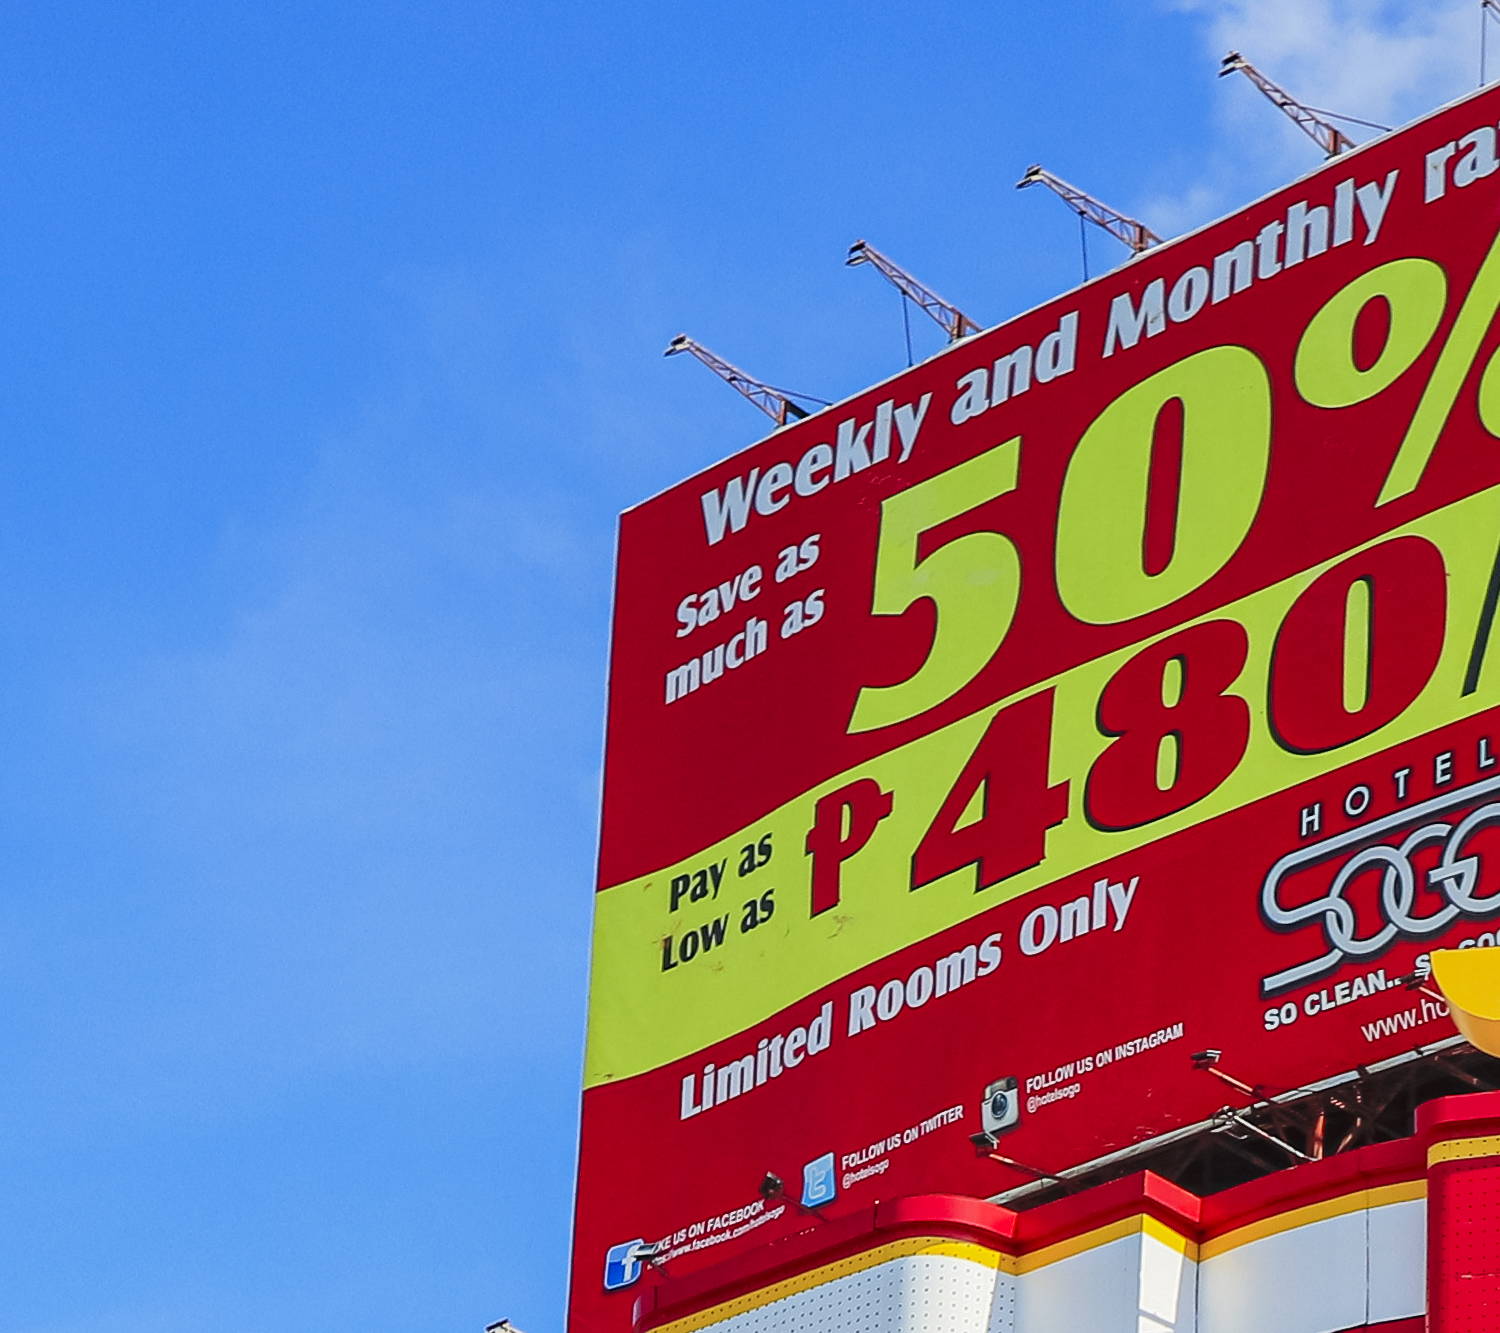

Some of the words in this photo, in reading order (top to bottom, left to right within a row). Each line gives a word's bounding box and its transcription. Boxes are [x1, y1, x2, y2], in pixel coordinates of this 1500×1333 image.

[701, 391, 930, 546] Weekly
[952, 312, 1080, 426] and
[1103, 169, 1400, 359] Monthly
[674, 563, 762, 640] Save
[775, 532, 821, 584] as
[664, 621, 768, 705] much
[780, 587, 826, 641] as
[1300, 739, 1495, 836] HOTEL
[667, 847, 729, 915] Pay
[738, 828, 774, 878] as
[661, 905, 728, 973] Low
[737, 887, 776, 937] as
[680, 1003, 834, 1121] Limited
[849, 933, 1001, 1038] Rooms
[1019, 875, 1139, 959] Only
[1264, 1003, 1297, 1031] SO
[1027, 1063, 1075, 1094] FOLLOW
[1076, 1057, 1093, 1075] US
[1096, 1049, 1113, 1068] ON
[1115, 1022, 1184, 1061] INSTAGRAM
[842, 1140, 886, 1170] FOLLOW
[887, 1133, 901, 1151] US
[903, 1126, 919, 1144] ON
[920, 1105, 964, 1135] TWITTER
[673, 1229, 687, 1246] US
[688, 1222, 705, 1239] ON
[706, 1199, 765, 1232] FACEBOOK
